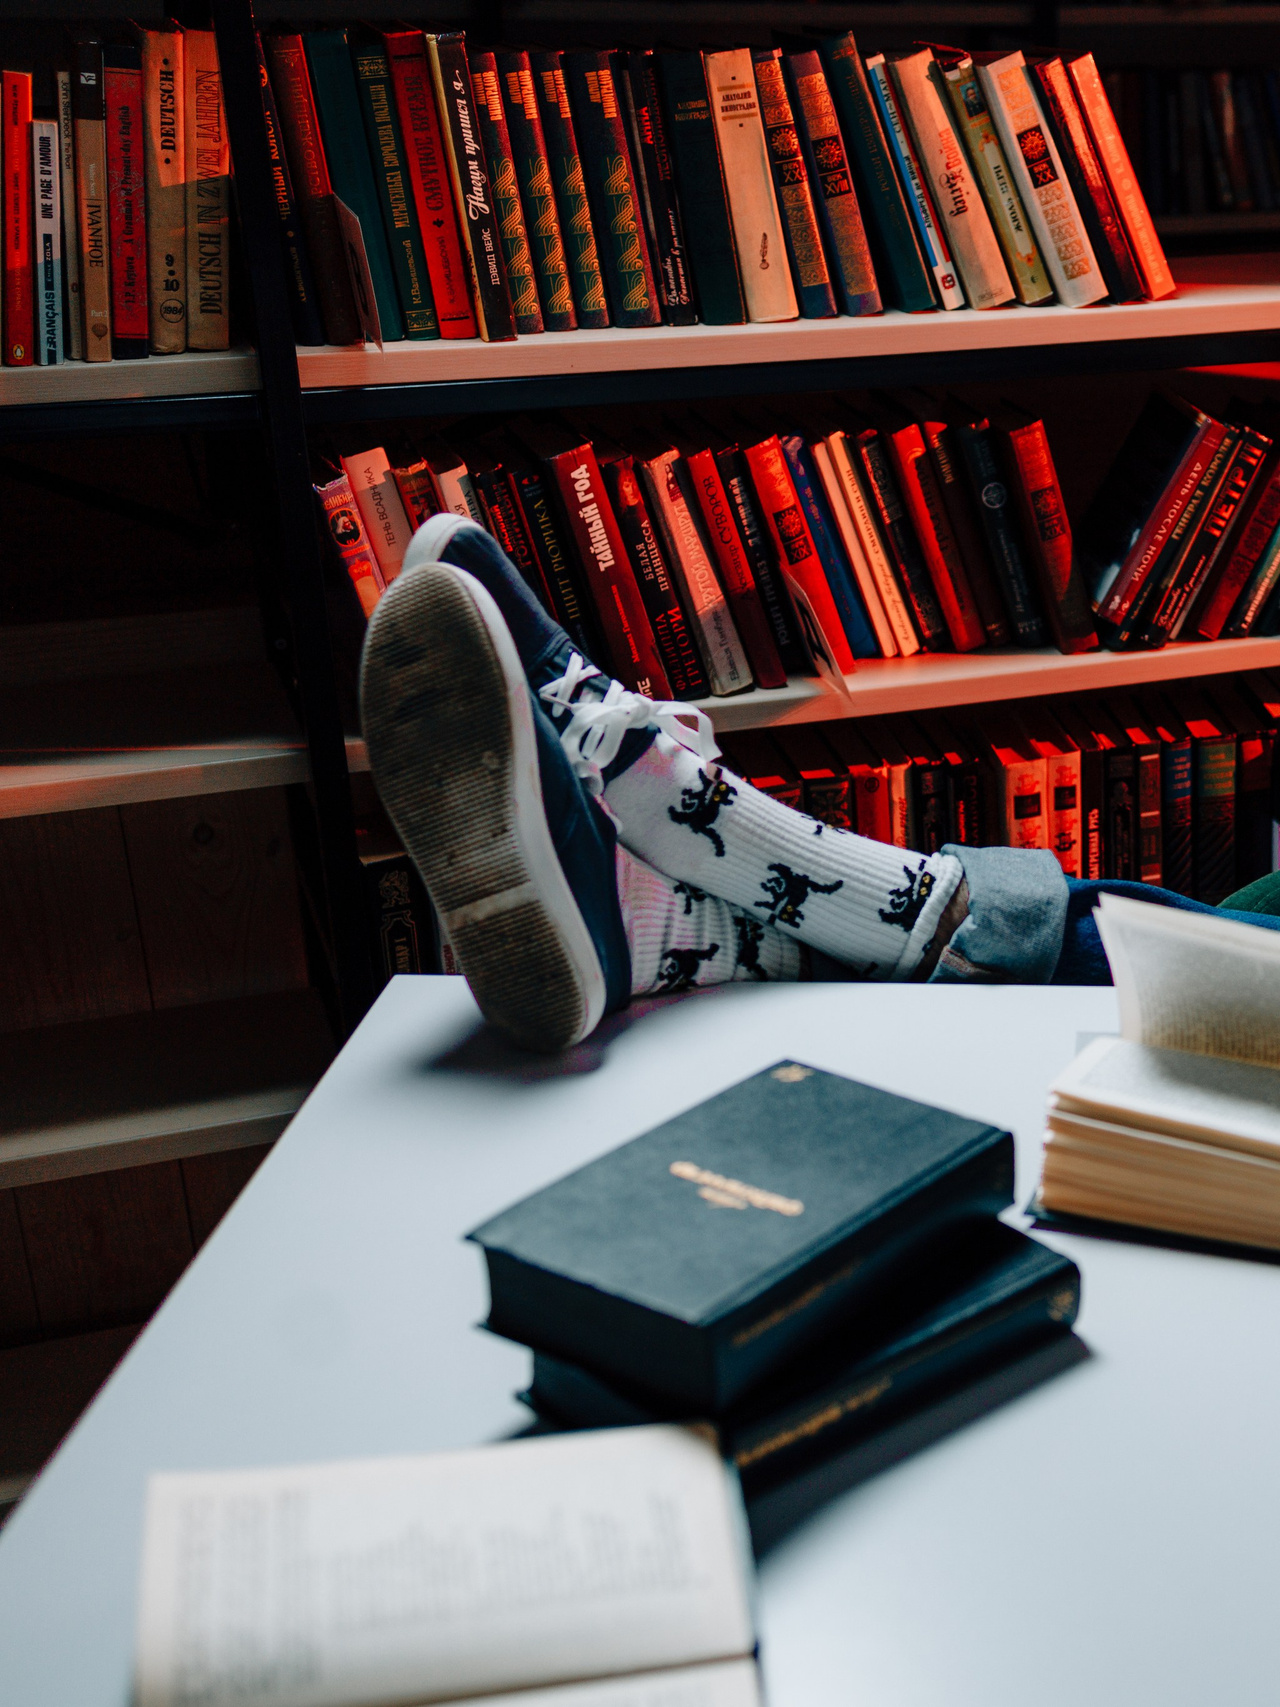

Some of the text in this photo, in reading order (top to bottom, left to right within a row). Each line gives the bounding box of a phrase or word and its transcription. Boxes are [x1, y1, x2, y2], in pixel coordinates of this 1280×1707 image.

[59, 80, 72, 138] John Steinbeck
[119, 105, 131, 134] English
[159, 70, 175, 152] DEUTSCH
[480, 69, 504, 122] ВИНОГРАДОВ
[515, 68, 541, 120] ВИНОГРАДОВ
[595, 68, 618, 119] ВИНОГРАДОВ
[720, 101, 756, 112] ВИНОГРАДОВ
[721, 90, 751, 101] АНАТОЛИЙ
[403, 74, 444, 212] СМУТНОЕ ВРЕМЯ
[449, 69, 490, 221] Нагим пришел я
[636, 106, 653, 145] АННА
[935, 127, 962, 171] Война
[38, 136, 53, 218] UNE PAGE D'AMOUR
[63, 141, 72, 169] The Pearl
[88, 162, 96, 180] Walter
[369, 83, 410, 228] МАРЫСЕНЬКА КОРОЛЕВА ПОЛЬШИ
[783, 168, 802, 182] XX
[1034, 168, 1055, 185] XX
[195, 68, 222, 315] DEUTSCH IN ZWEI JAHREN
[271, 165, 291, 221] ЧЕРНЫЙ
[824, 178, 849, 195] XVIII
[85, 203, 103, 267] IVANHOE
[121, 199, 133, 235] Grammar
[1003, 197, 1023, 234] ЖЮЛЬ
[479, 226, 503, 286] ДЭВИД ВЕЙС
[163, 279, 180, 291] 10
[163, 305, 183, 316] 1984
[91, 309, 103, 318] Part
[362, 465, 396, 547] ТЕНЬ ВСАДНИКА
[845, 468, 859, 493] СЫН
[1170, 436, 1233, 541] ГЕНЕРАЛ КОРОЛЯ
[1202, 442, 1264, 538] ПЕТР II
[489, 503, 513, 553] ВАСИЛИЙ
[492, 480, 532, 568] ГОЛИЦЫН
[568, 463, 616, 572] ТАЙНЫЙ ГОД
[701, 475, 734, 544] СУВОРОВ
[1131, 460, 1203, 583] ДЕНЬ ПОСЛЕ НОЧИ
[531, 497, 582, 620] ЩИТ РЮРИКА
[635, 542, 655, 580] БЕЛАЯ
[638, 519, 670, 591] ПРИНЦЕССА
[672, 502, 720, 608] КРУТОЙ МАРШРУТ
[790, 545, 810, 560] XIX
[666, 606, 702, 686] ГРЕГОРИ
[769, 605, 790, 645] РОБЕРТ
[654, 612, 688, 691] ФИЛИППА
[1088, 808, 1099, 829] РУСЬ
